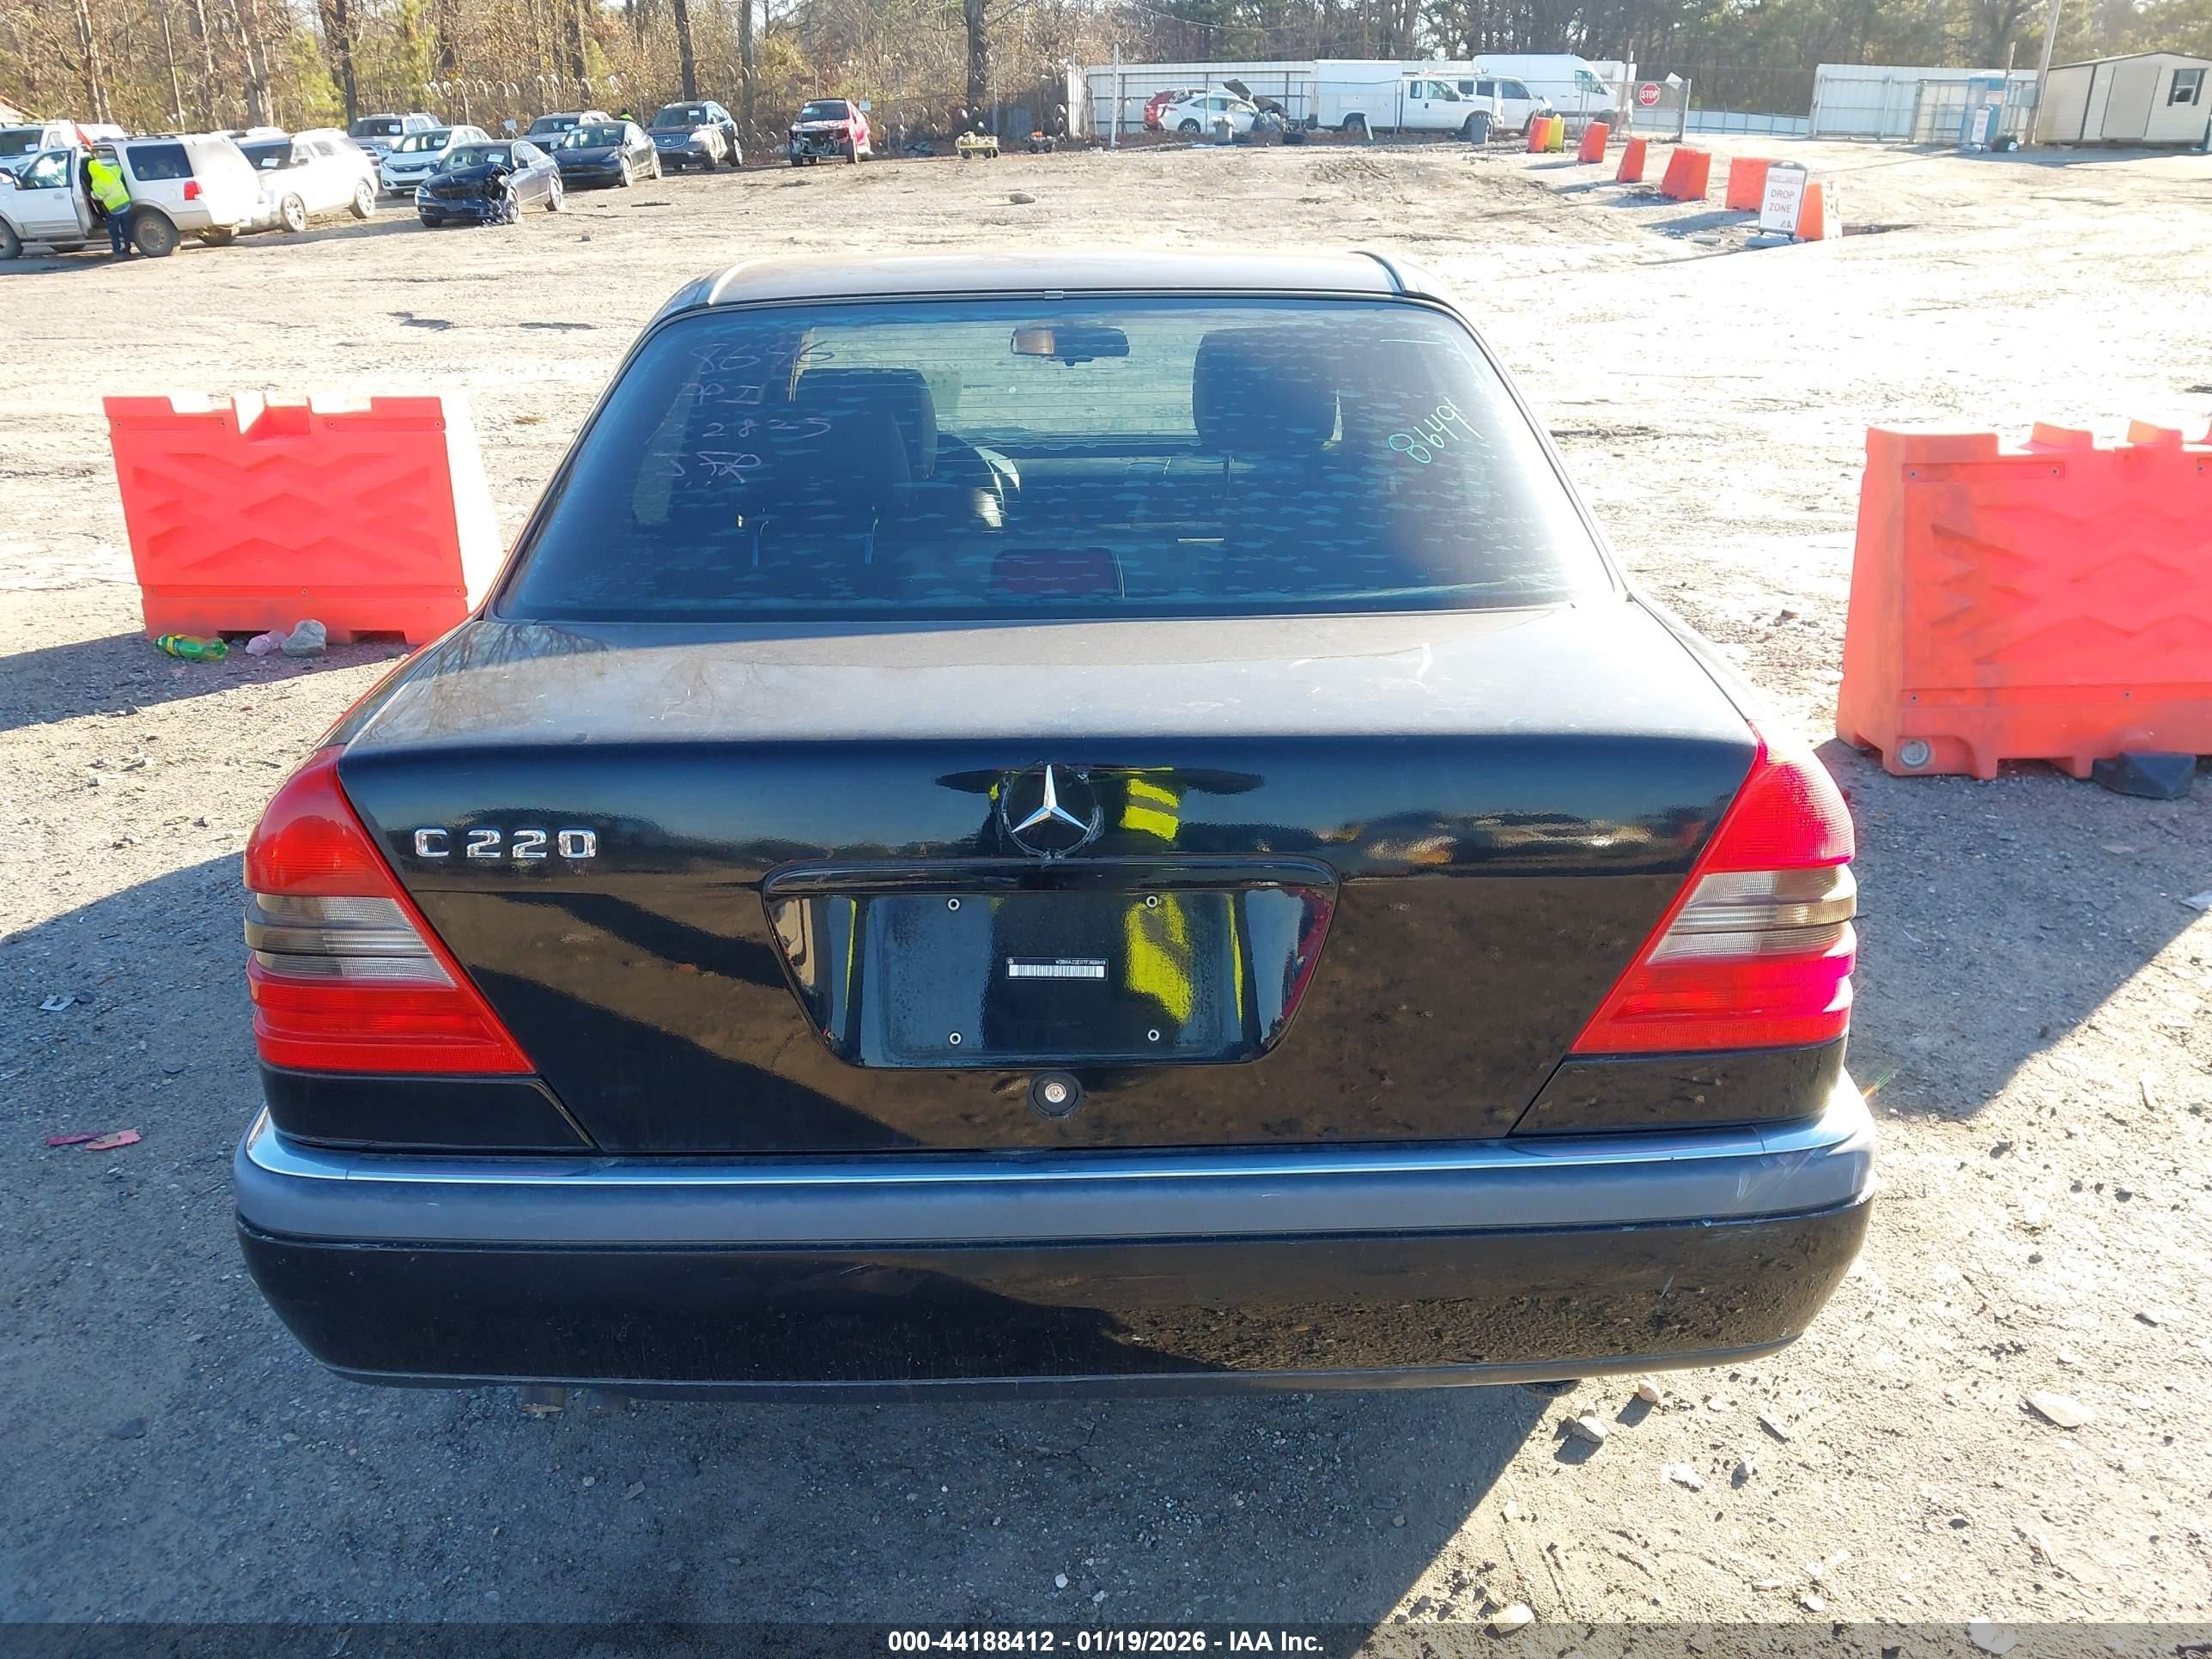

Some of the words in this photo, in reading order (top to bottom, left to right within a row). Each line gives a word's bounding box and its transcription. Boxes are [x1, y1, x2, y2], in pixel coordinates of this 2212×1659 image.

[1641, 89, 1658, 100] STOP
[1771, 189, 1795, 199] DROP
[1769, 203, 1792, 213] ZONE
[413, 828, 449, 858] C
[466, 828, 598, 859] 220
